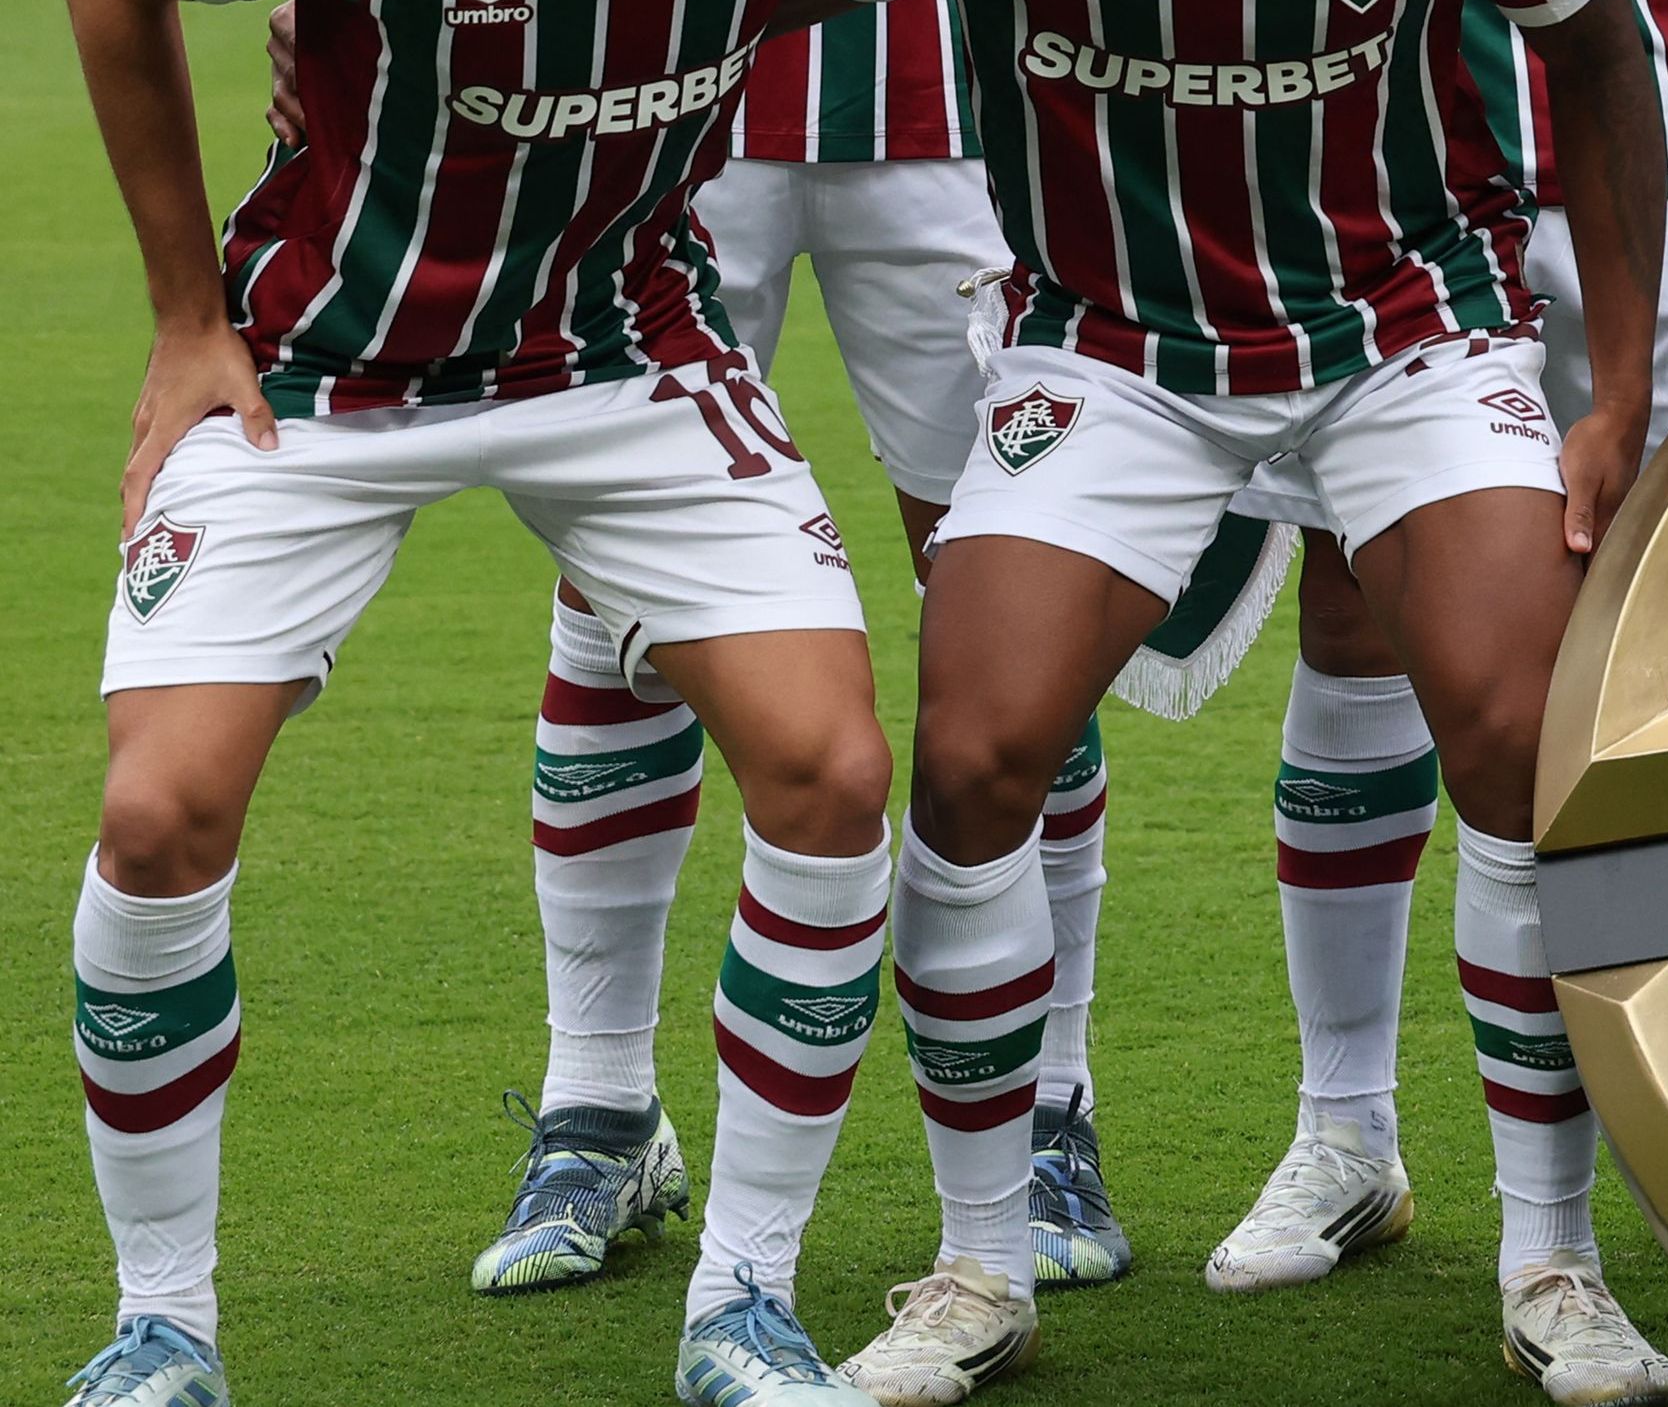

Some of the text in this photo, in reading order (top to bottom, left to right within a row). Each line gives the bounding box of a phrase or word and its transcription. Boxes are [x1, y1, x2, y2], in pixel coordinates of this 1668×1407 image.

[446, 5, 531, 24] umbro
[1026, 30, 1388, 107] SUPERBET
[1489, 421, 1550, 447] umbro
[80, 1022, 168, 1053] umbro
[779, 1013, 868, 1040] umbro
